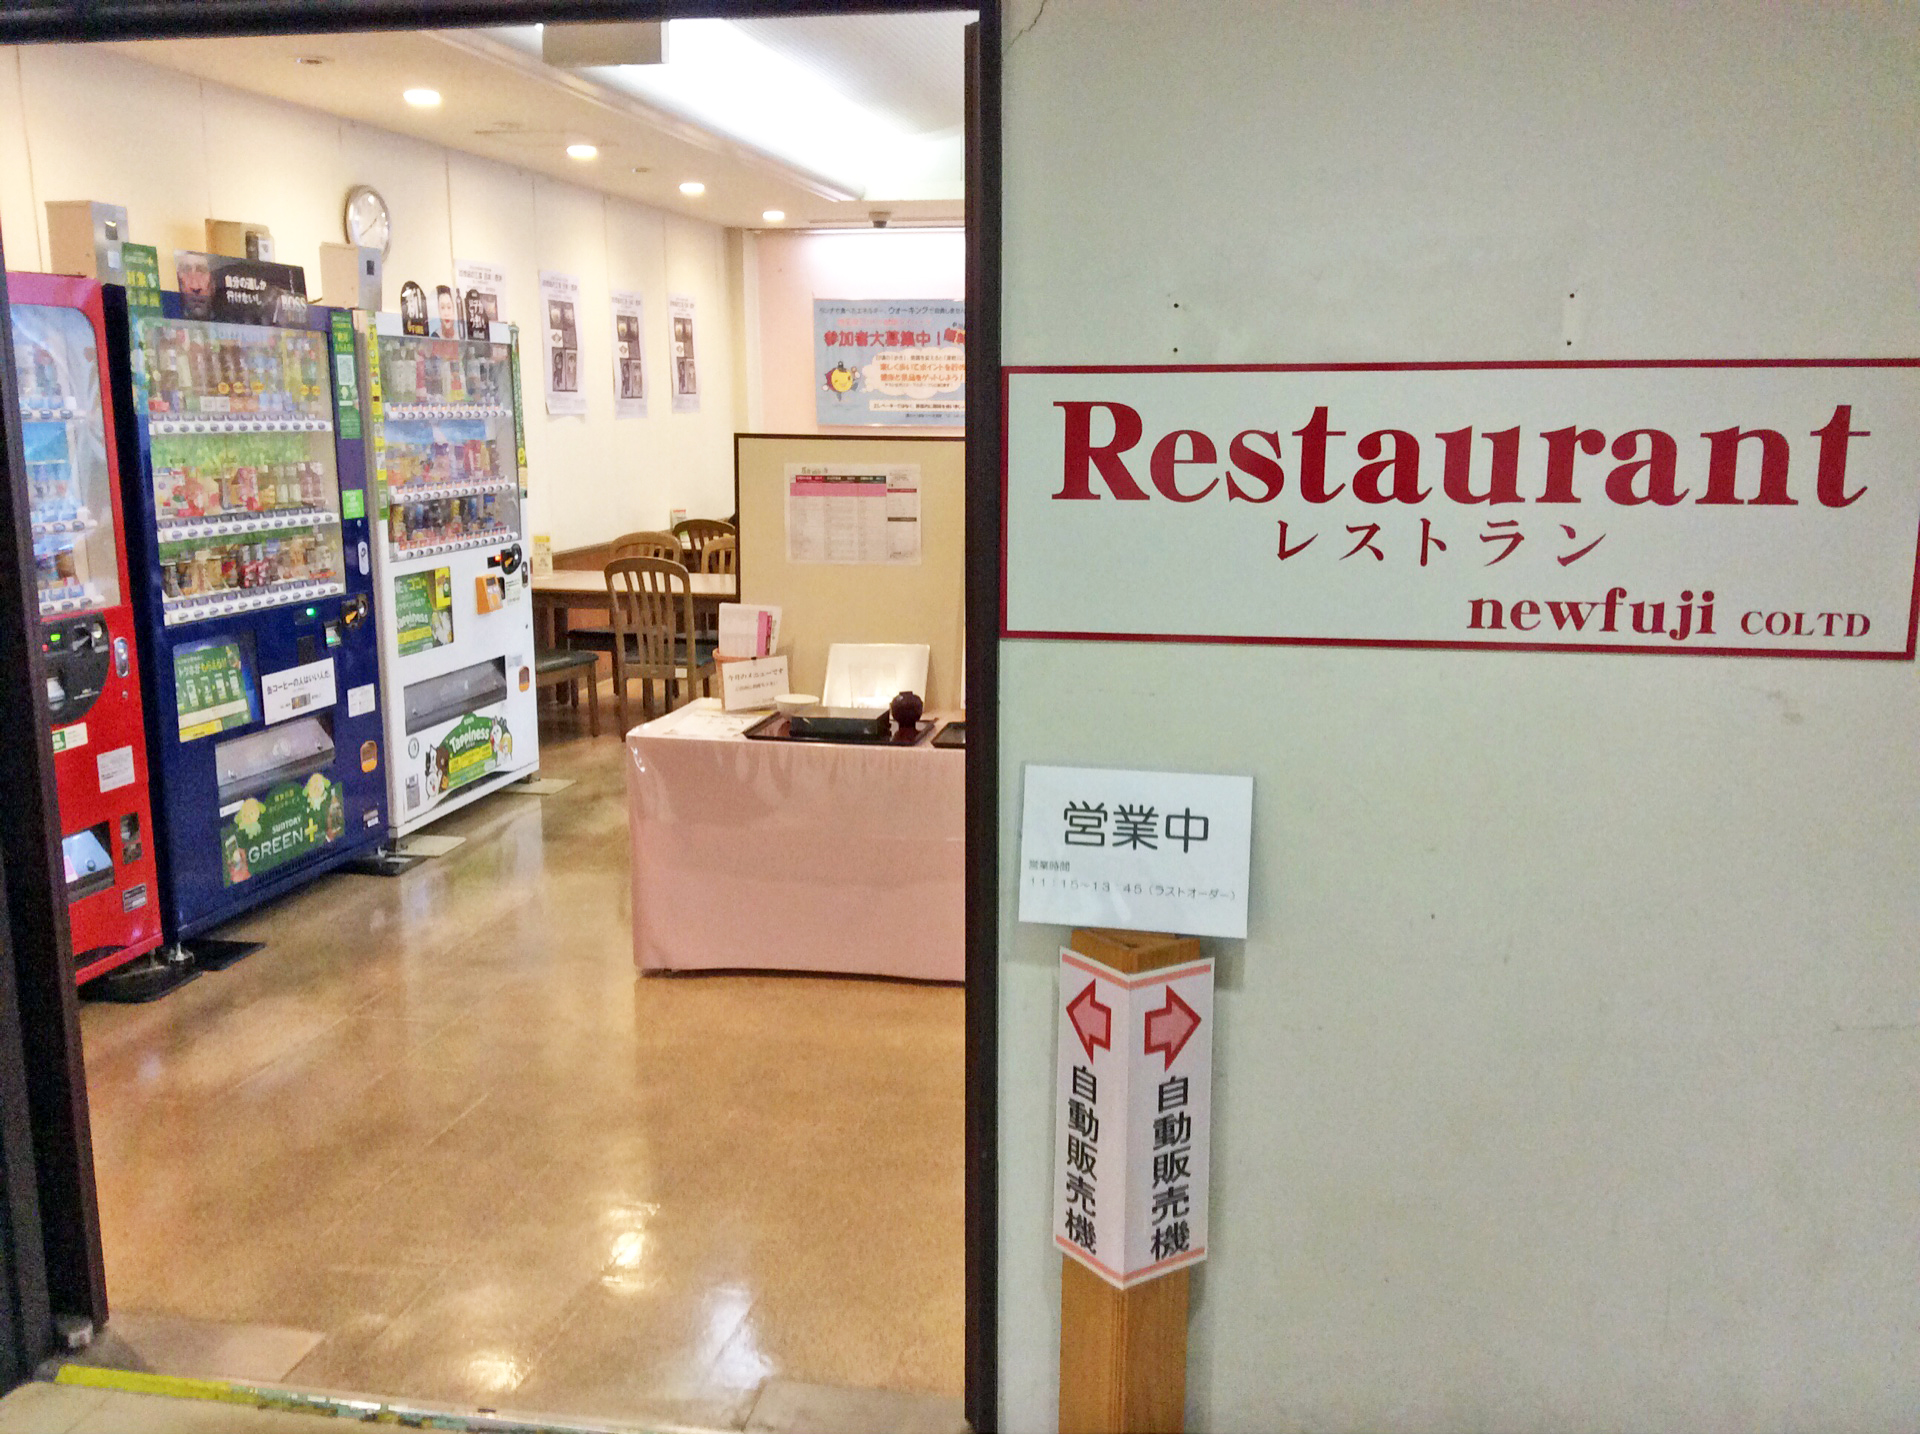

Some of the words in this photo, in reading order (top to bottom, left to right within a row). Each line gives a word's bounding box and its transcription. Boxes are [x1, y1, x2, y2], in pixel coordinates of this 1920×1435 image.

[1053, 402, 1871, 508] Restaurant
[1277, 518, 1605, 568] レストラン
[1467, 586, 1717, 642] newfuji
[272, 815, 302, 834] SUNTORY
[1063, 800, 1210, 854] 営業中
[1028, 860, 1071, 873] 営業時間
[1065, 1064, 1099, 1256] 自動販売機
[1150, 1075, 1191, 1262] 自動販売機
